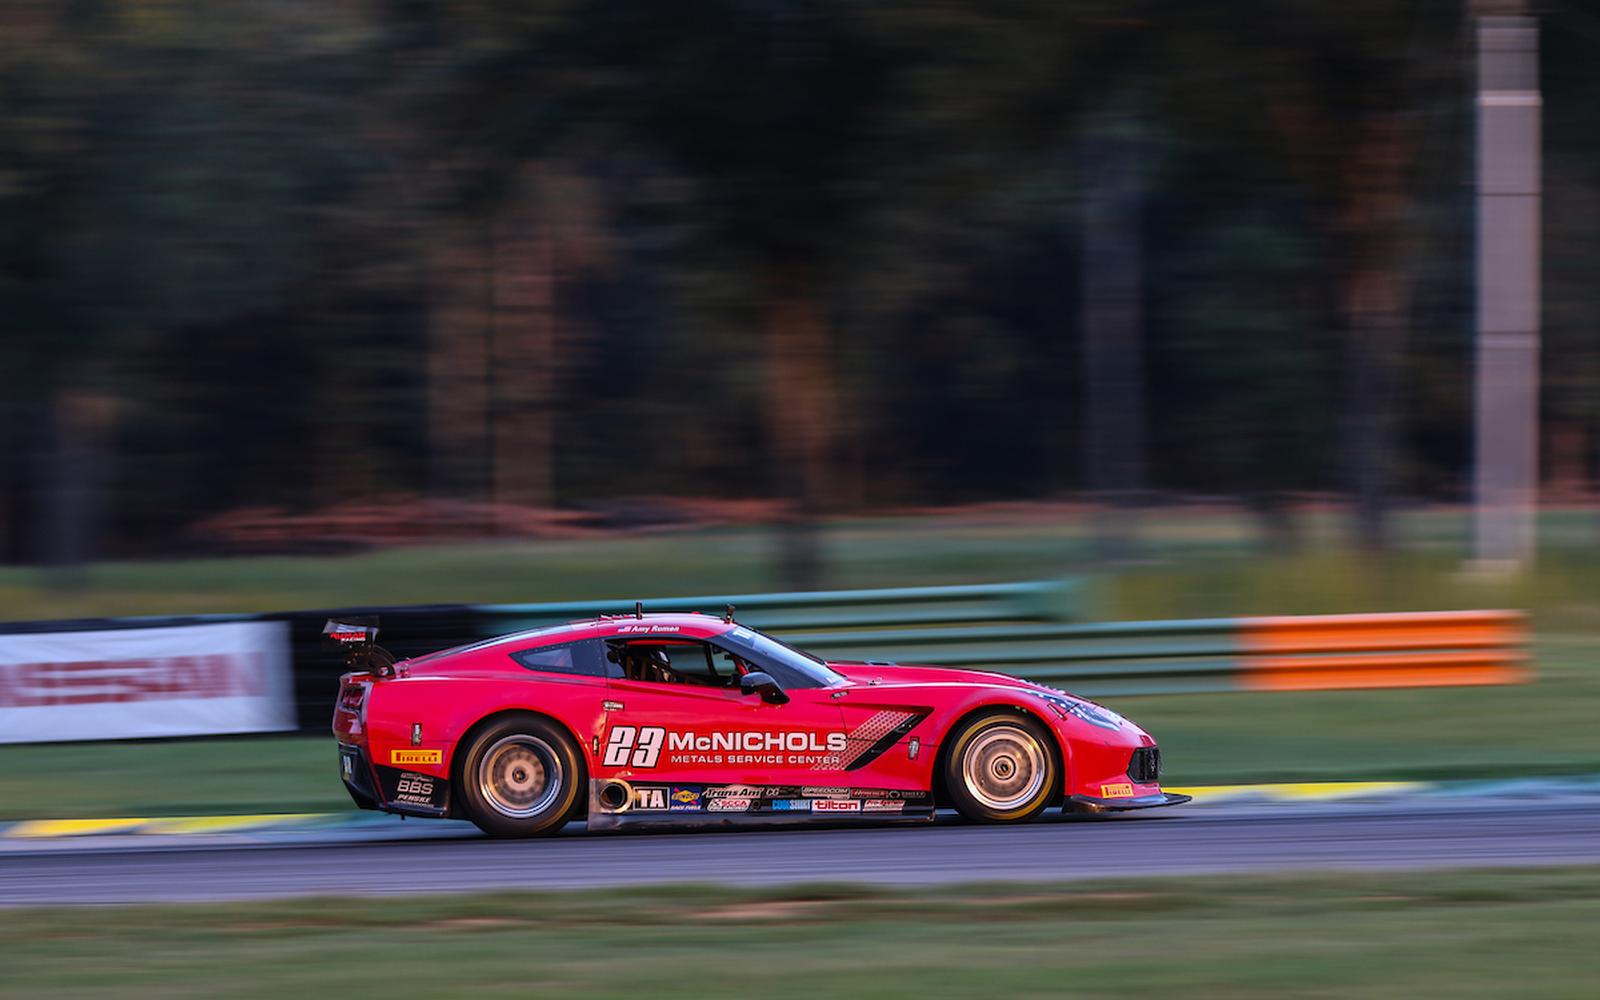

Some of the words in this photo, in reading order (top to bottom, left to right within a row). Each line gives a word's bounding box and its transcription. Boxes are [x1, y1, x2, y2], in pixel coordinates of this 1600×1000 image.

[603, 726, 665, 768] 23
[669, 732, 847, 752] McNICHOLS
[671, 755, 723, 764] METALS
[728, 755, 783, 764] SERVICE
[788, 756, 840, 765] CENTER
[397, 780, 433, 795] BBS
[398, 793, 432, 803] PENSKE
[638, 790, 665, 808] TA
[721, 799, 747, 807] SCCA
[815, 800, 858, 810] tilton
